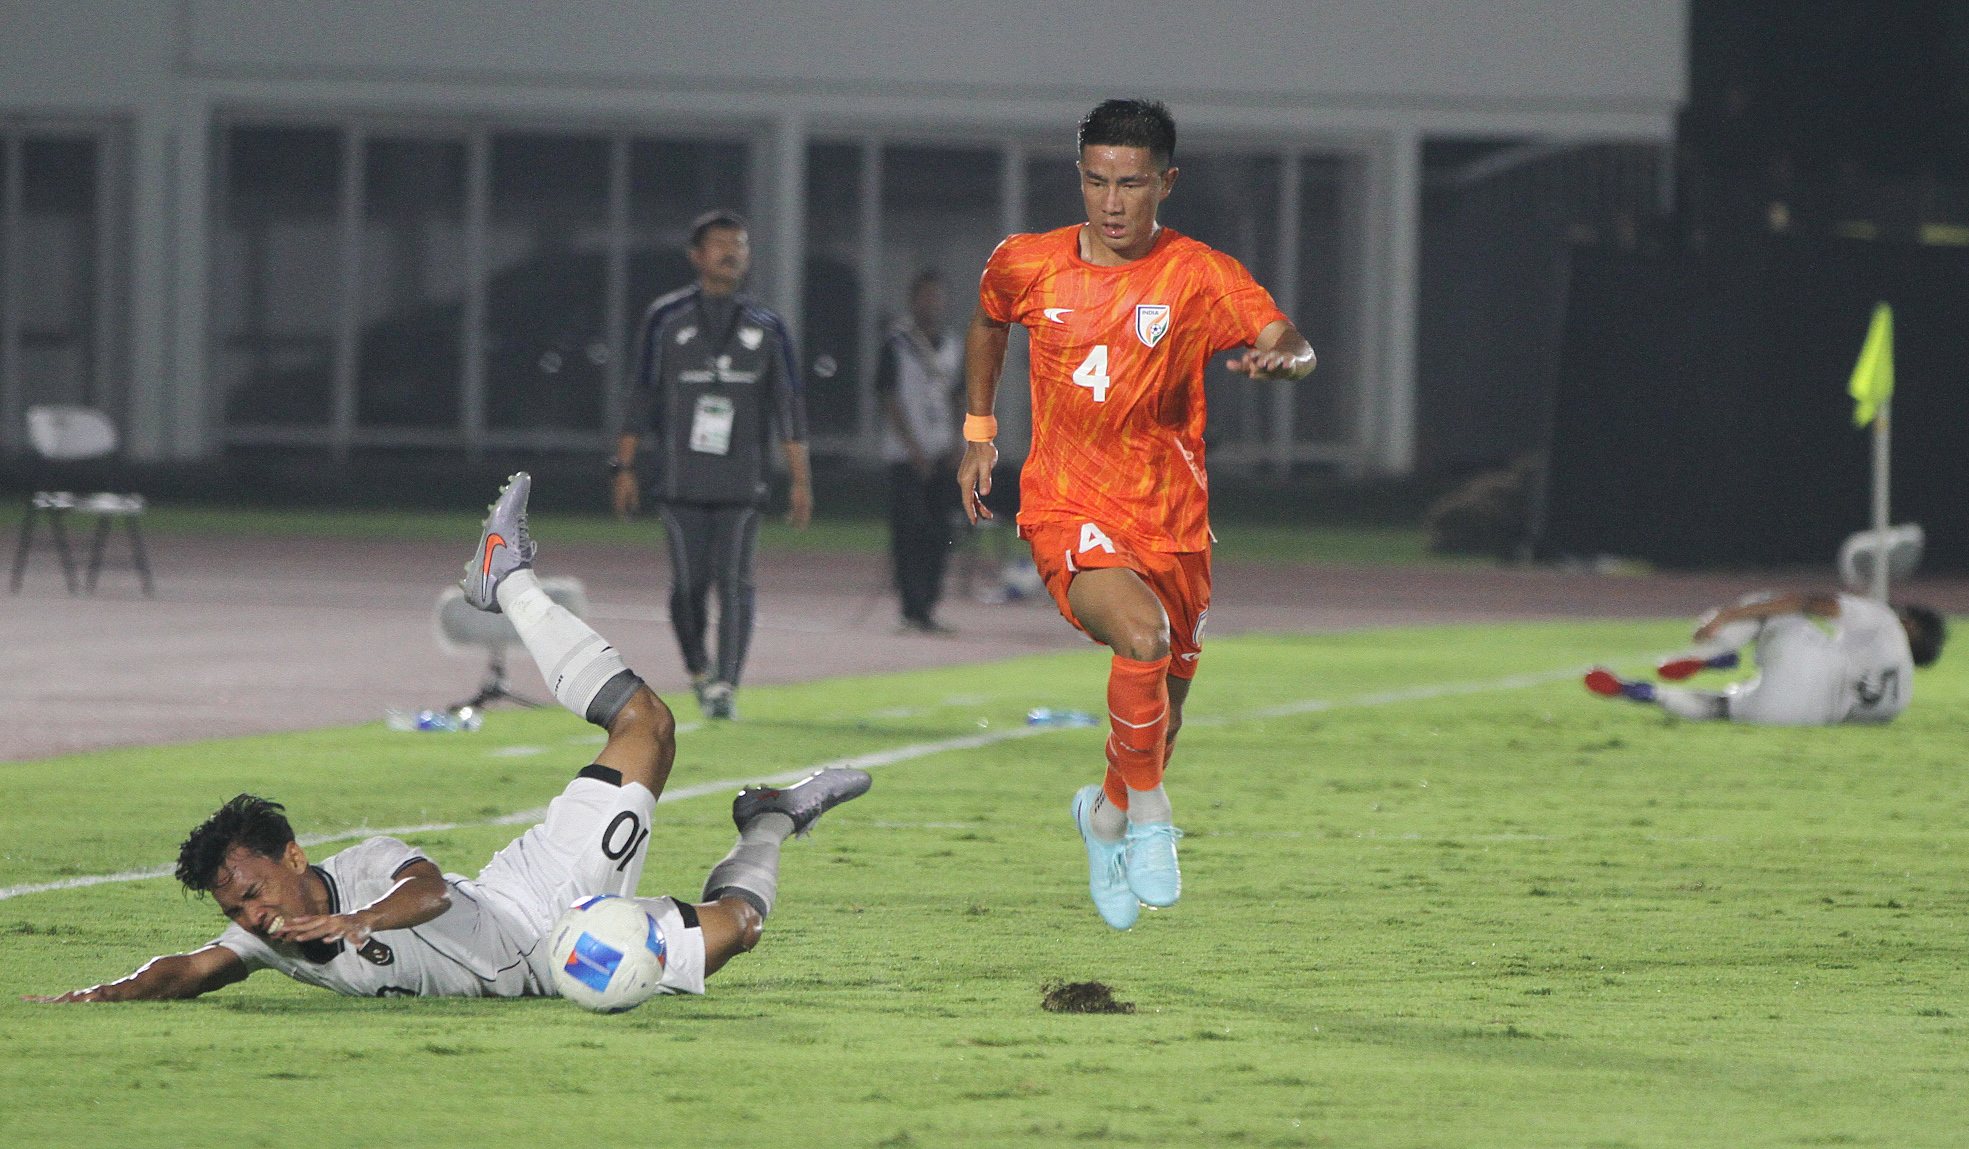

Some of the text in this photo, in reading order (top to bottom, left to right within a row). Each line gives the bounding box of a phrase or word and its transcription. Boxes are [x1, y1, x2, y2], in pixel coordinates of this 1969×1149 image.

[1072, 345, 1110, 402] 4
[1078, 522, 1116, 553] 4
[602, 810, 649, 872] 10
